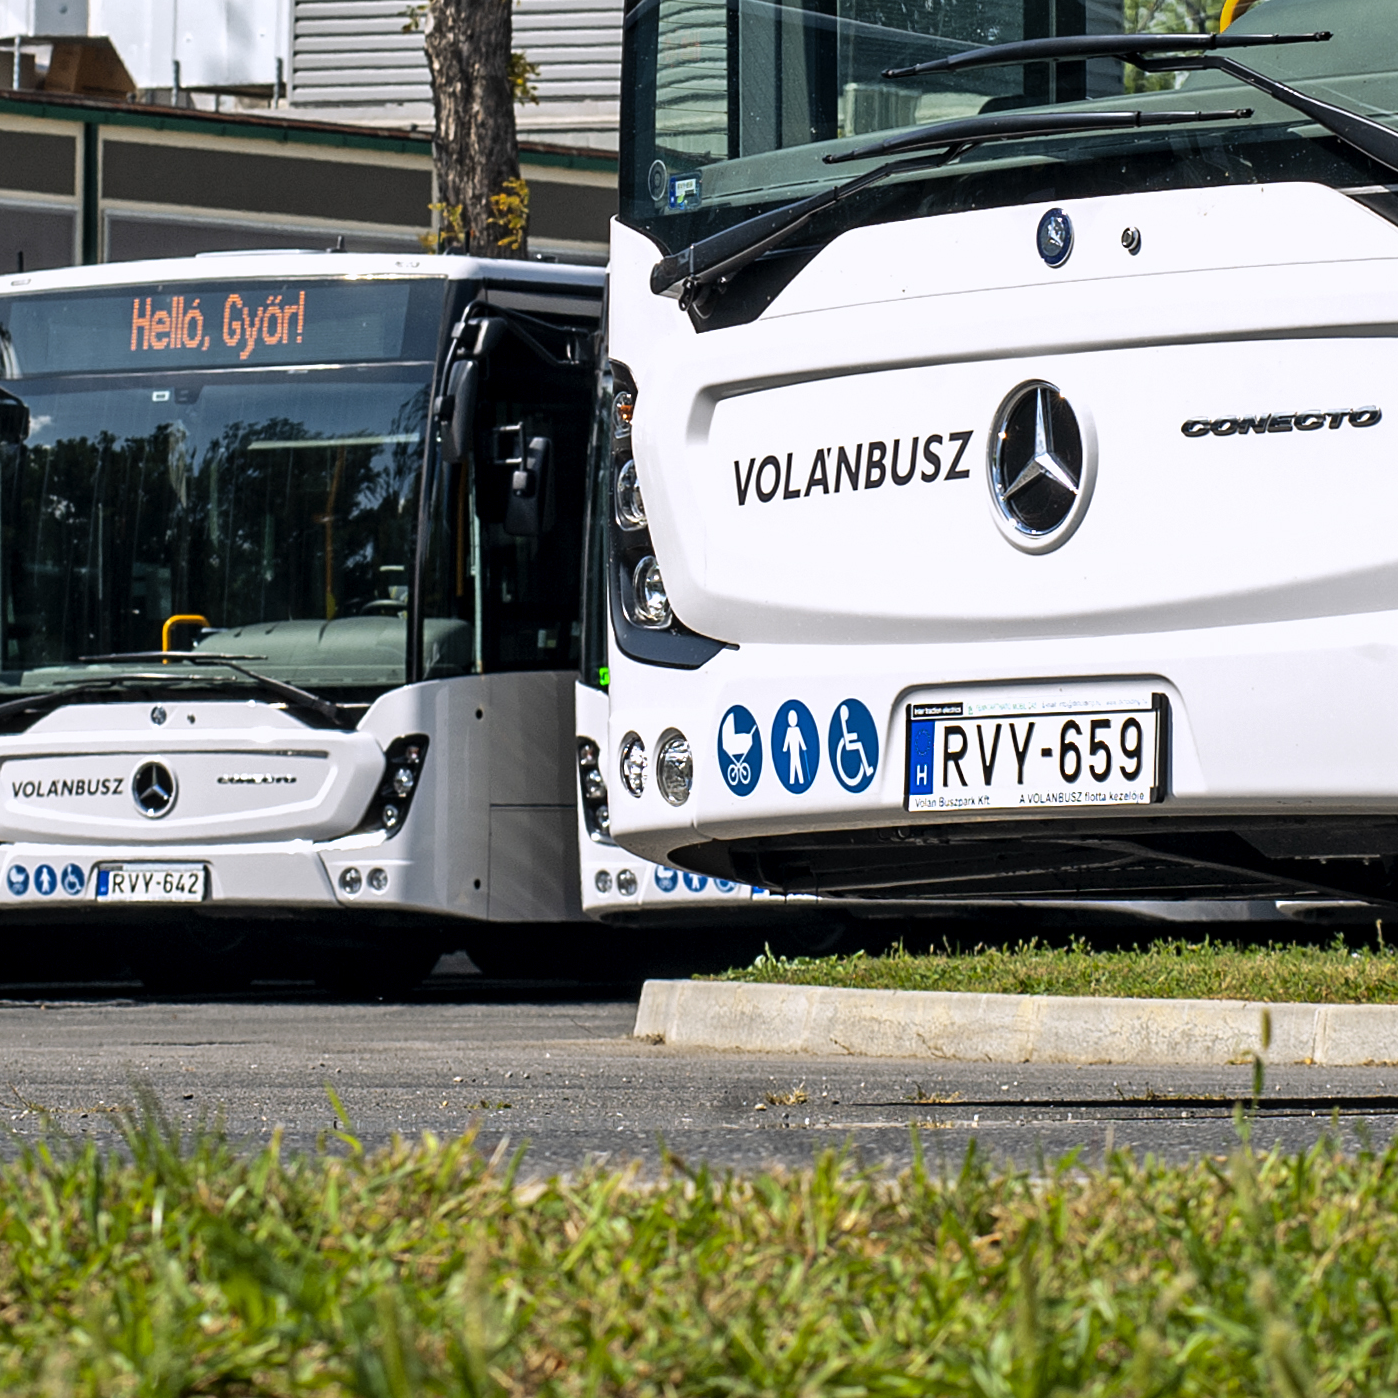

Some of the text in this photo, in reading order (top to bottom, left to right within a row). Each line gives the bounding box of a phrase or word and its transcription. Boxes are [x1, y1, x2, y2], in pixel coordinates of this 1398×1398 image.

[130, 290, 306, 361] Helló, Győr!
[1180, 404, 1384, 438] CONECTO
[733, 430, 975, 507] VOLÁNBUSZ
[943, 717, 1143, 787] RVY-659
[11, 777, 124, 798] VOLÁNBUSZ
[916, 763, 928, 787] H
[112, 872, 199, 894] RVY-642
